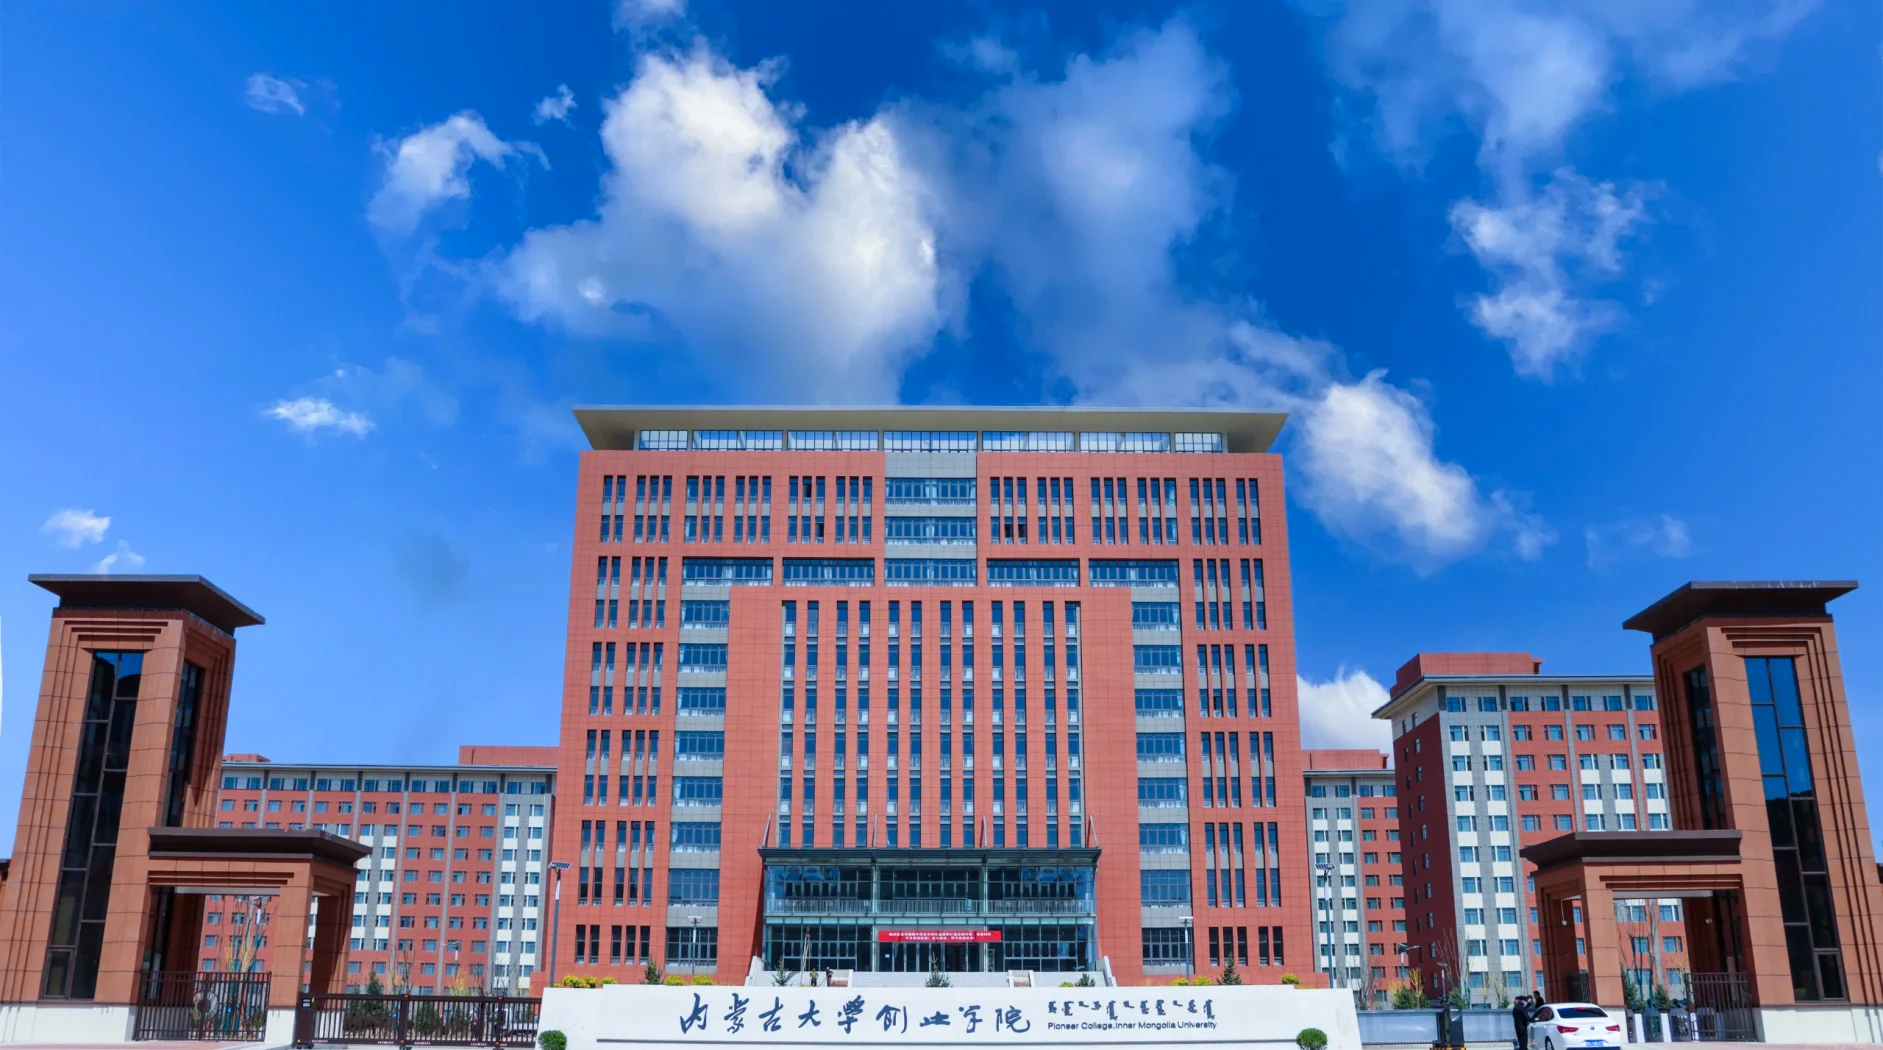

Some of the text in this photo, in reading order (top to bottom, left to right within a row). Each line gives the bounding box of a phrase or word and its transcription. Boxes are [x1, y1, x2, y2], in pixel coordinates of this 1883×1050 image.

[1047, 1021, 1079, 1030] Pioneer
[1138, 1021, 1176, 1031] Mongolia
[1177, 1021, 1217, 1030] University
